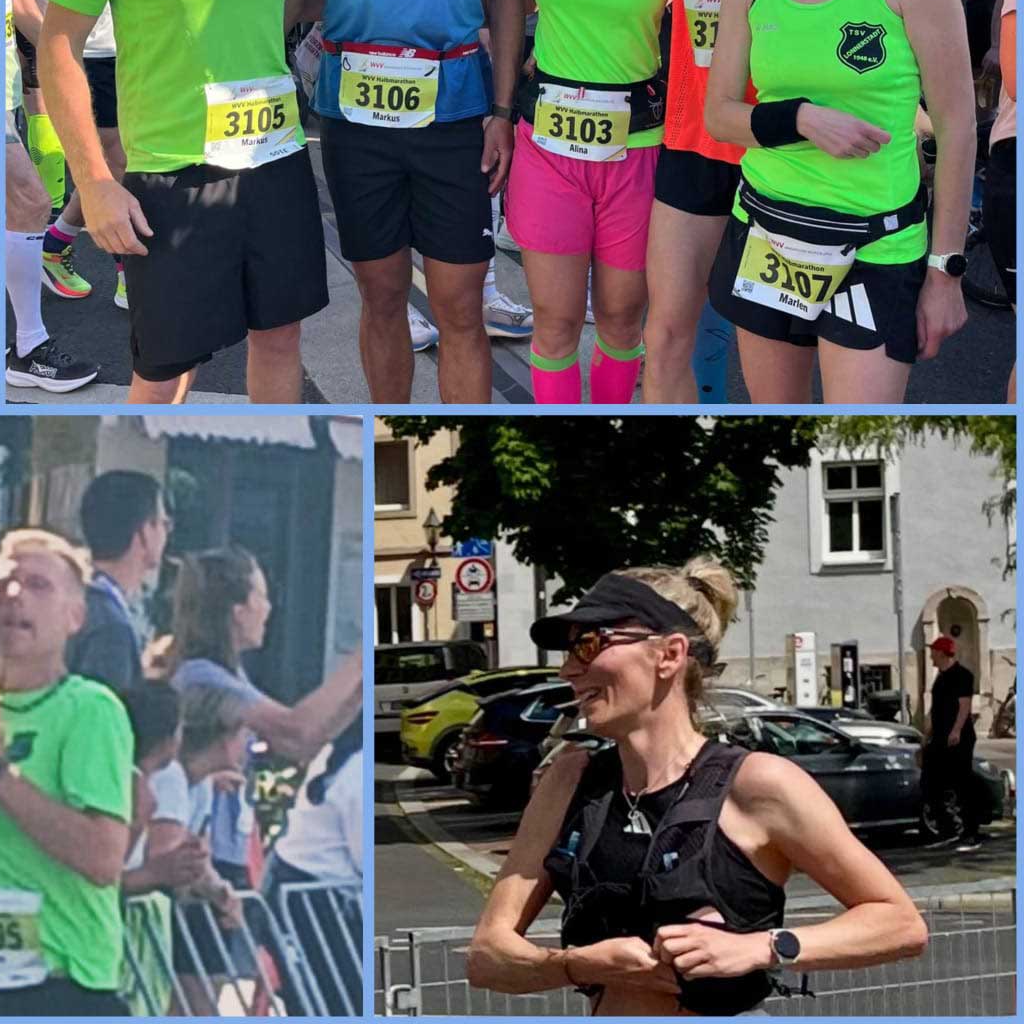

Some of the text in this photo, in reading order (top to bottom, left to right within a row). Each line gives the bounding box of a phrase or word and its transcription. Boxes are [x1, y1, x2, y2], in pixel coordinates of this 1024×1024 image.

[694, 20, 719, 48] 31
[355, 82, 421, 111] 3106
[224, 104, 286, 137] 3105
[373, 112, 400, 122] Markus
[549, 113, 613, 144] 3103
[242, 137, 268, 146] Markus
[569, 144, 588, 154] Alina
[788, 259, 825, 272] bmarathon
[760, 253, 833, 302] 3107
[779, 293, 808, 312] Marlen
